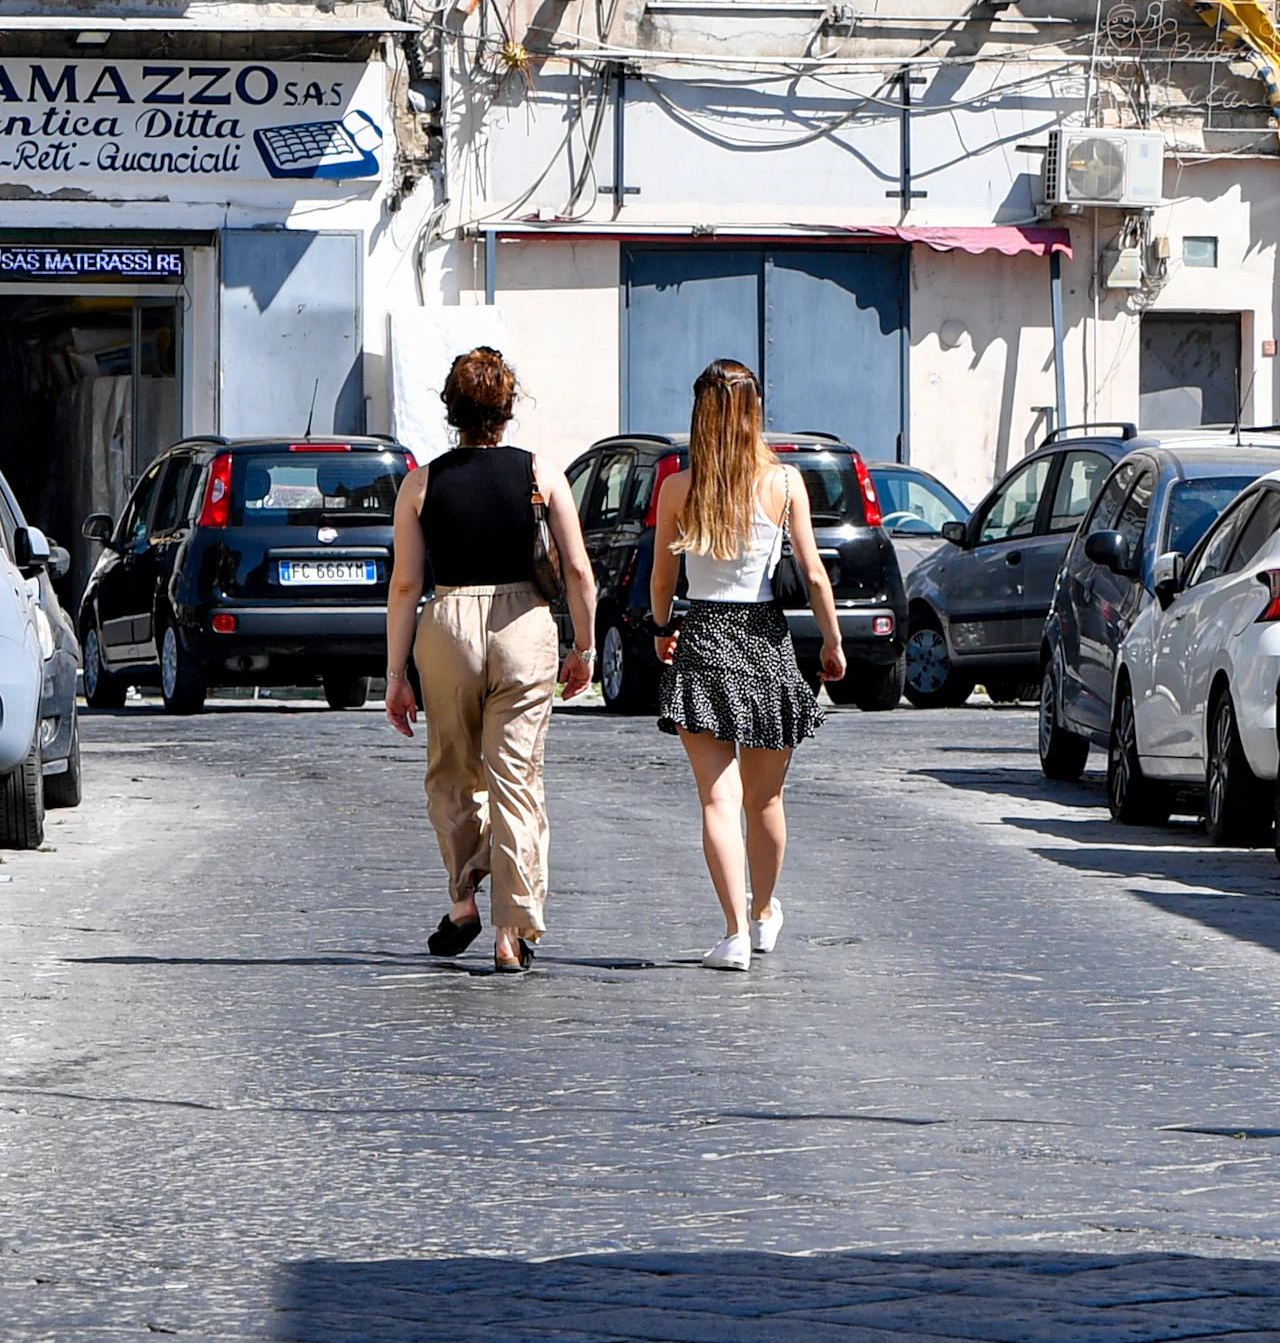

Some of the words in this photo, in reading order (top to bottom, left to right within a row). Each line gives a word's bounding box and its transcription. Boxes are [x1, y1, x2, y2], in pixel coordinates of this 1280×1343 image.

[135, 108, 246, 139] Ditta
[97, 142, 241, 174] Guanciali
[1, 253, 40, 271] SAS
[44, 253, 153, 271] MATERASSI
[291, 563, 311, 579] FC
